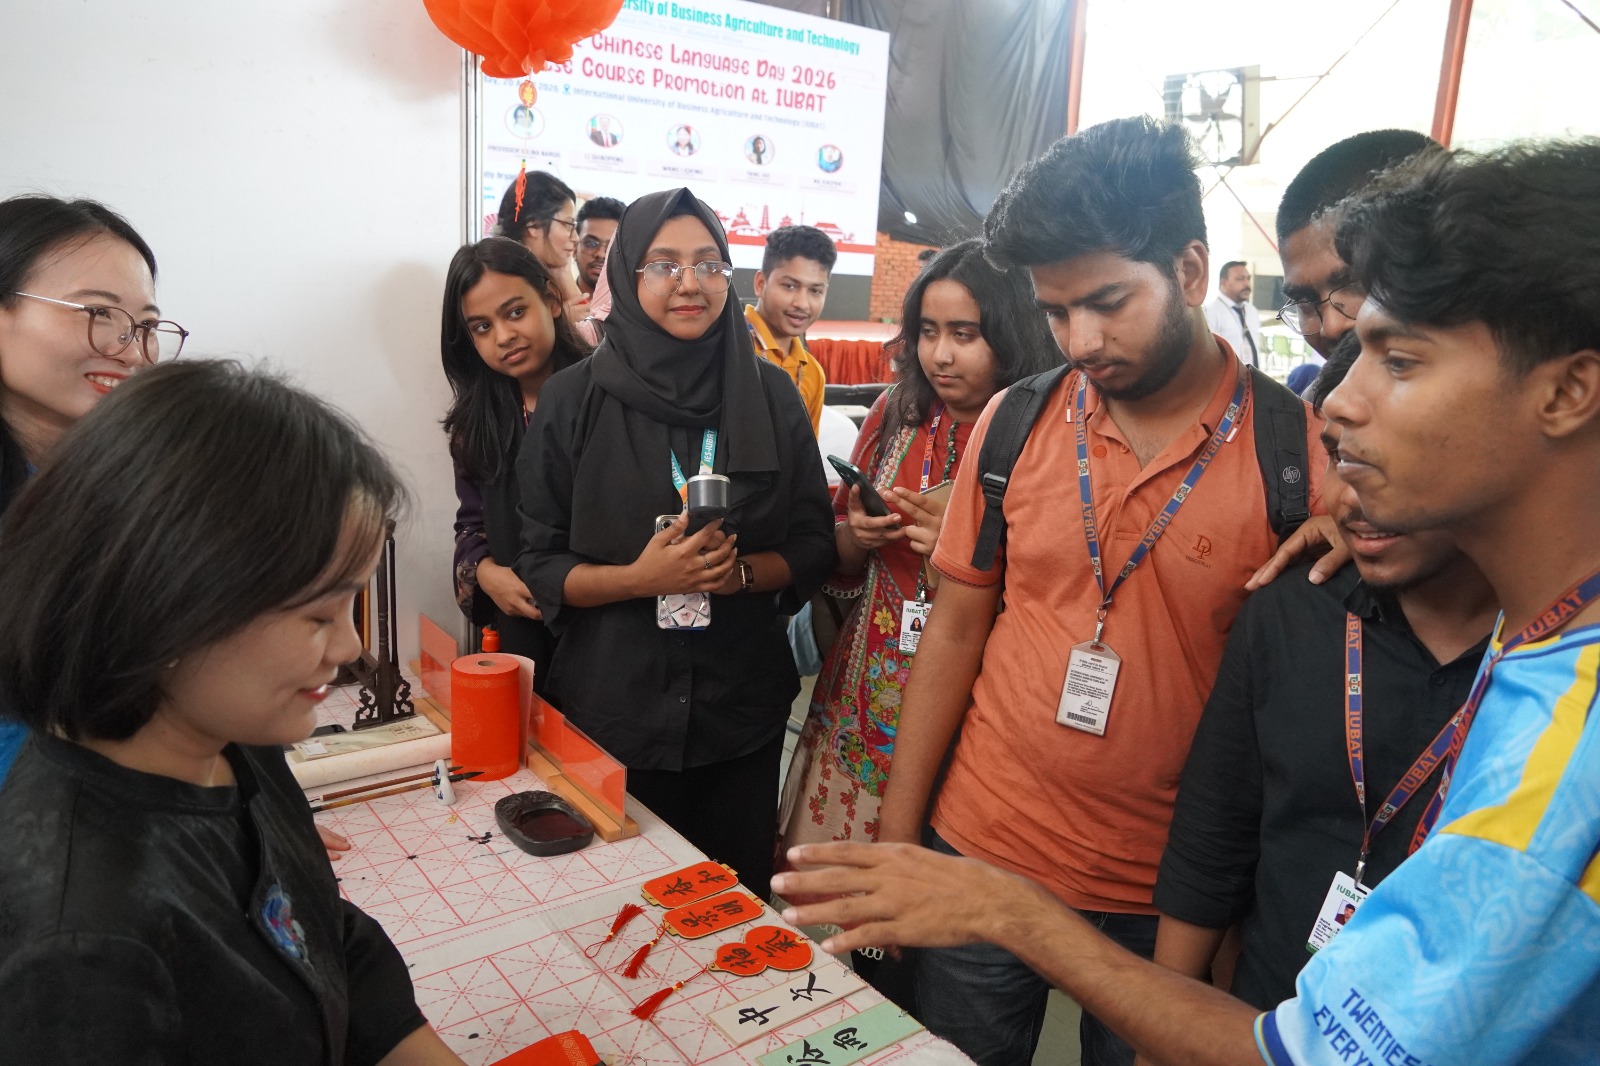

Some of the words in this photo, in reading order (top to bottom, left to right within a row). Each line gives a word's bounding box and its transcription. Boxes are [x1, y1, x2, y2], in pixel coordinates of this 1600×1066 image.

[657, 2, 668, 16] of
[671, 3, 722, 26] Business
[725, 13, 783, 38] Agriculture
[786, 28, 804, 43] and
[807, 30, 860, 55] Technology
[792, 65, 836, 90] 2026
[627, 95, 665, 108] University
[776, 88, 826, 113] IUBAT
[1077, 408, 1085, 446] IUBAT
[1198, 430, 1226, 469] IUBAT
[1082, 502, 1097, 542] IUBAT
[1142, 511, 1172, 549] IUBAT
[1522, 589, 1582, 640] IUBAT
[1348, 711, 1360, 761] IUBAT
[1400, 750, 1439, 793] IUBAT
[1336, 884, 1362, 903] IUBAT
[680, 899, 745, 928] 景明
[738, 971, 834, 1026] 中文
[786, 1027, 868, 1066] 谷雨
[1313, 1004, 1374, 1066] EVERY
